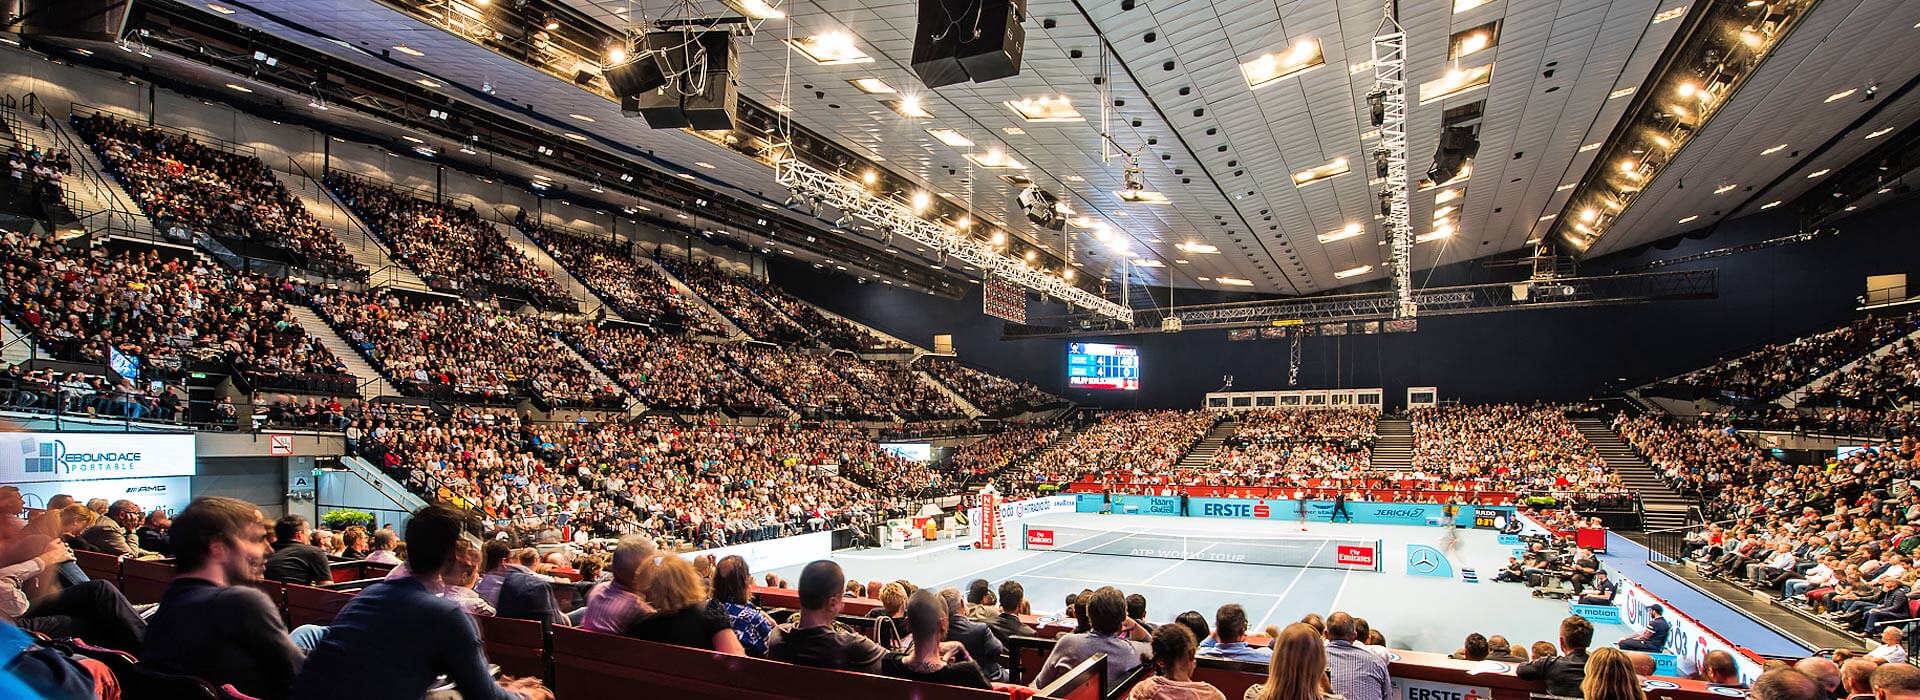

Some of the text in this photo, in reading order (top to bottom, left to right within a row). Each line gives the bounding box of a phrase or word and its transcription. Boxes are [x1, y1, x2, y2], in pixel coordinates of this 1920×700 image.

[1097, 356, 1103, 365] 4
[1097, 366, 1103, 376] 4
[72, 463, 134, 472] PORTABLE
[296, 478, 307, 486] A
[1204, 503, 1250, 517] ERSTE
[1374, 509, 1410, 517] JERICH
[1131, 548, 1154, 556] ATP
[1210, 552, 1247, 562] TOUR
[1339, 553, 1371, 563] Emirates
[1585, 608, 1616, 617] motion
[1409, 687, 1461, 700] ERSTE
